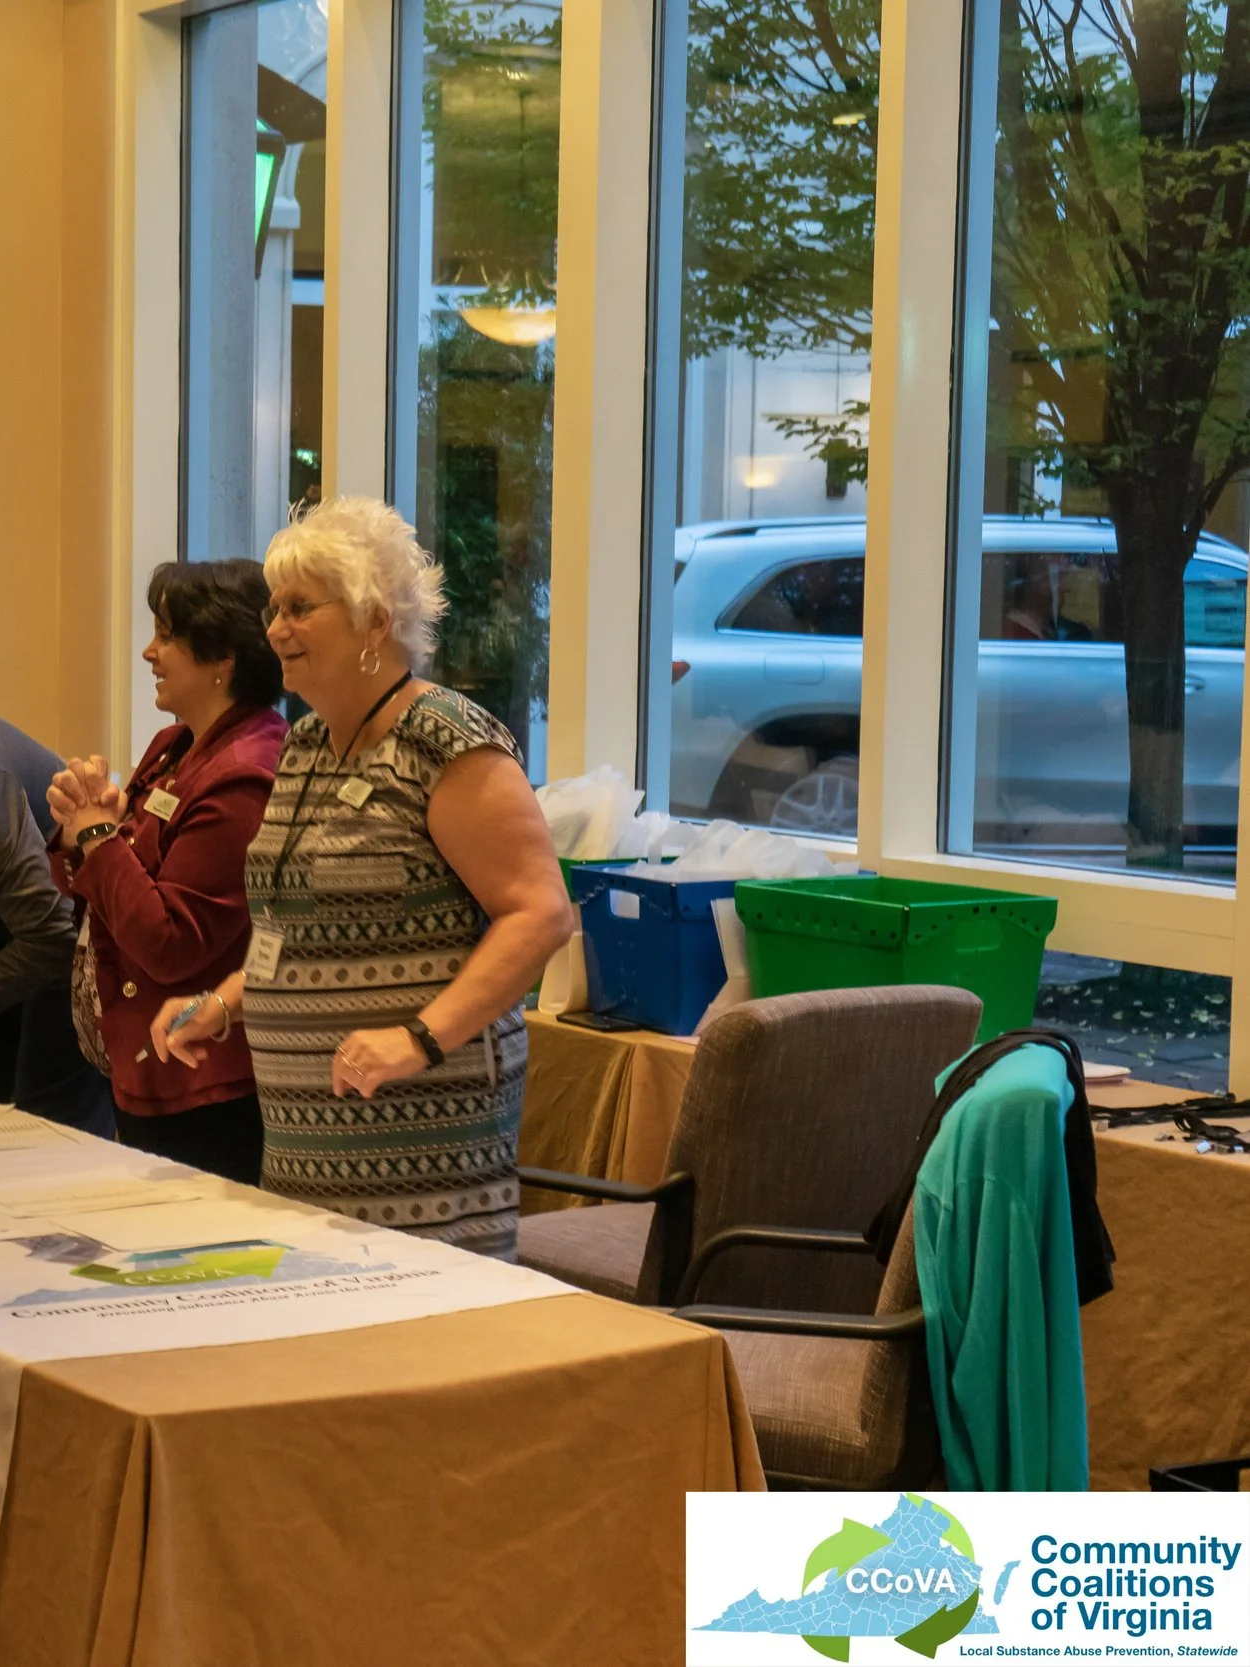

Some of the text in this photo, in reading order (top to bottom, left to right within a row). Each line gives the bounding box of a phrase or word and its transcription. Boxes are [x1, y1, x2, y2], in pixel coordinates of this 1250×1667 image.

[11, 1269, 443, 1320] Community Coalitions of Virginia
